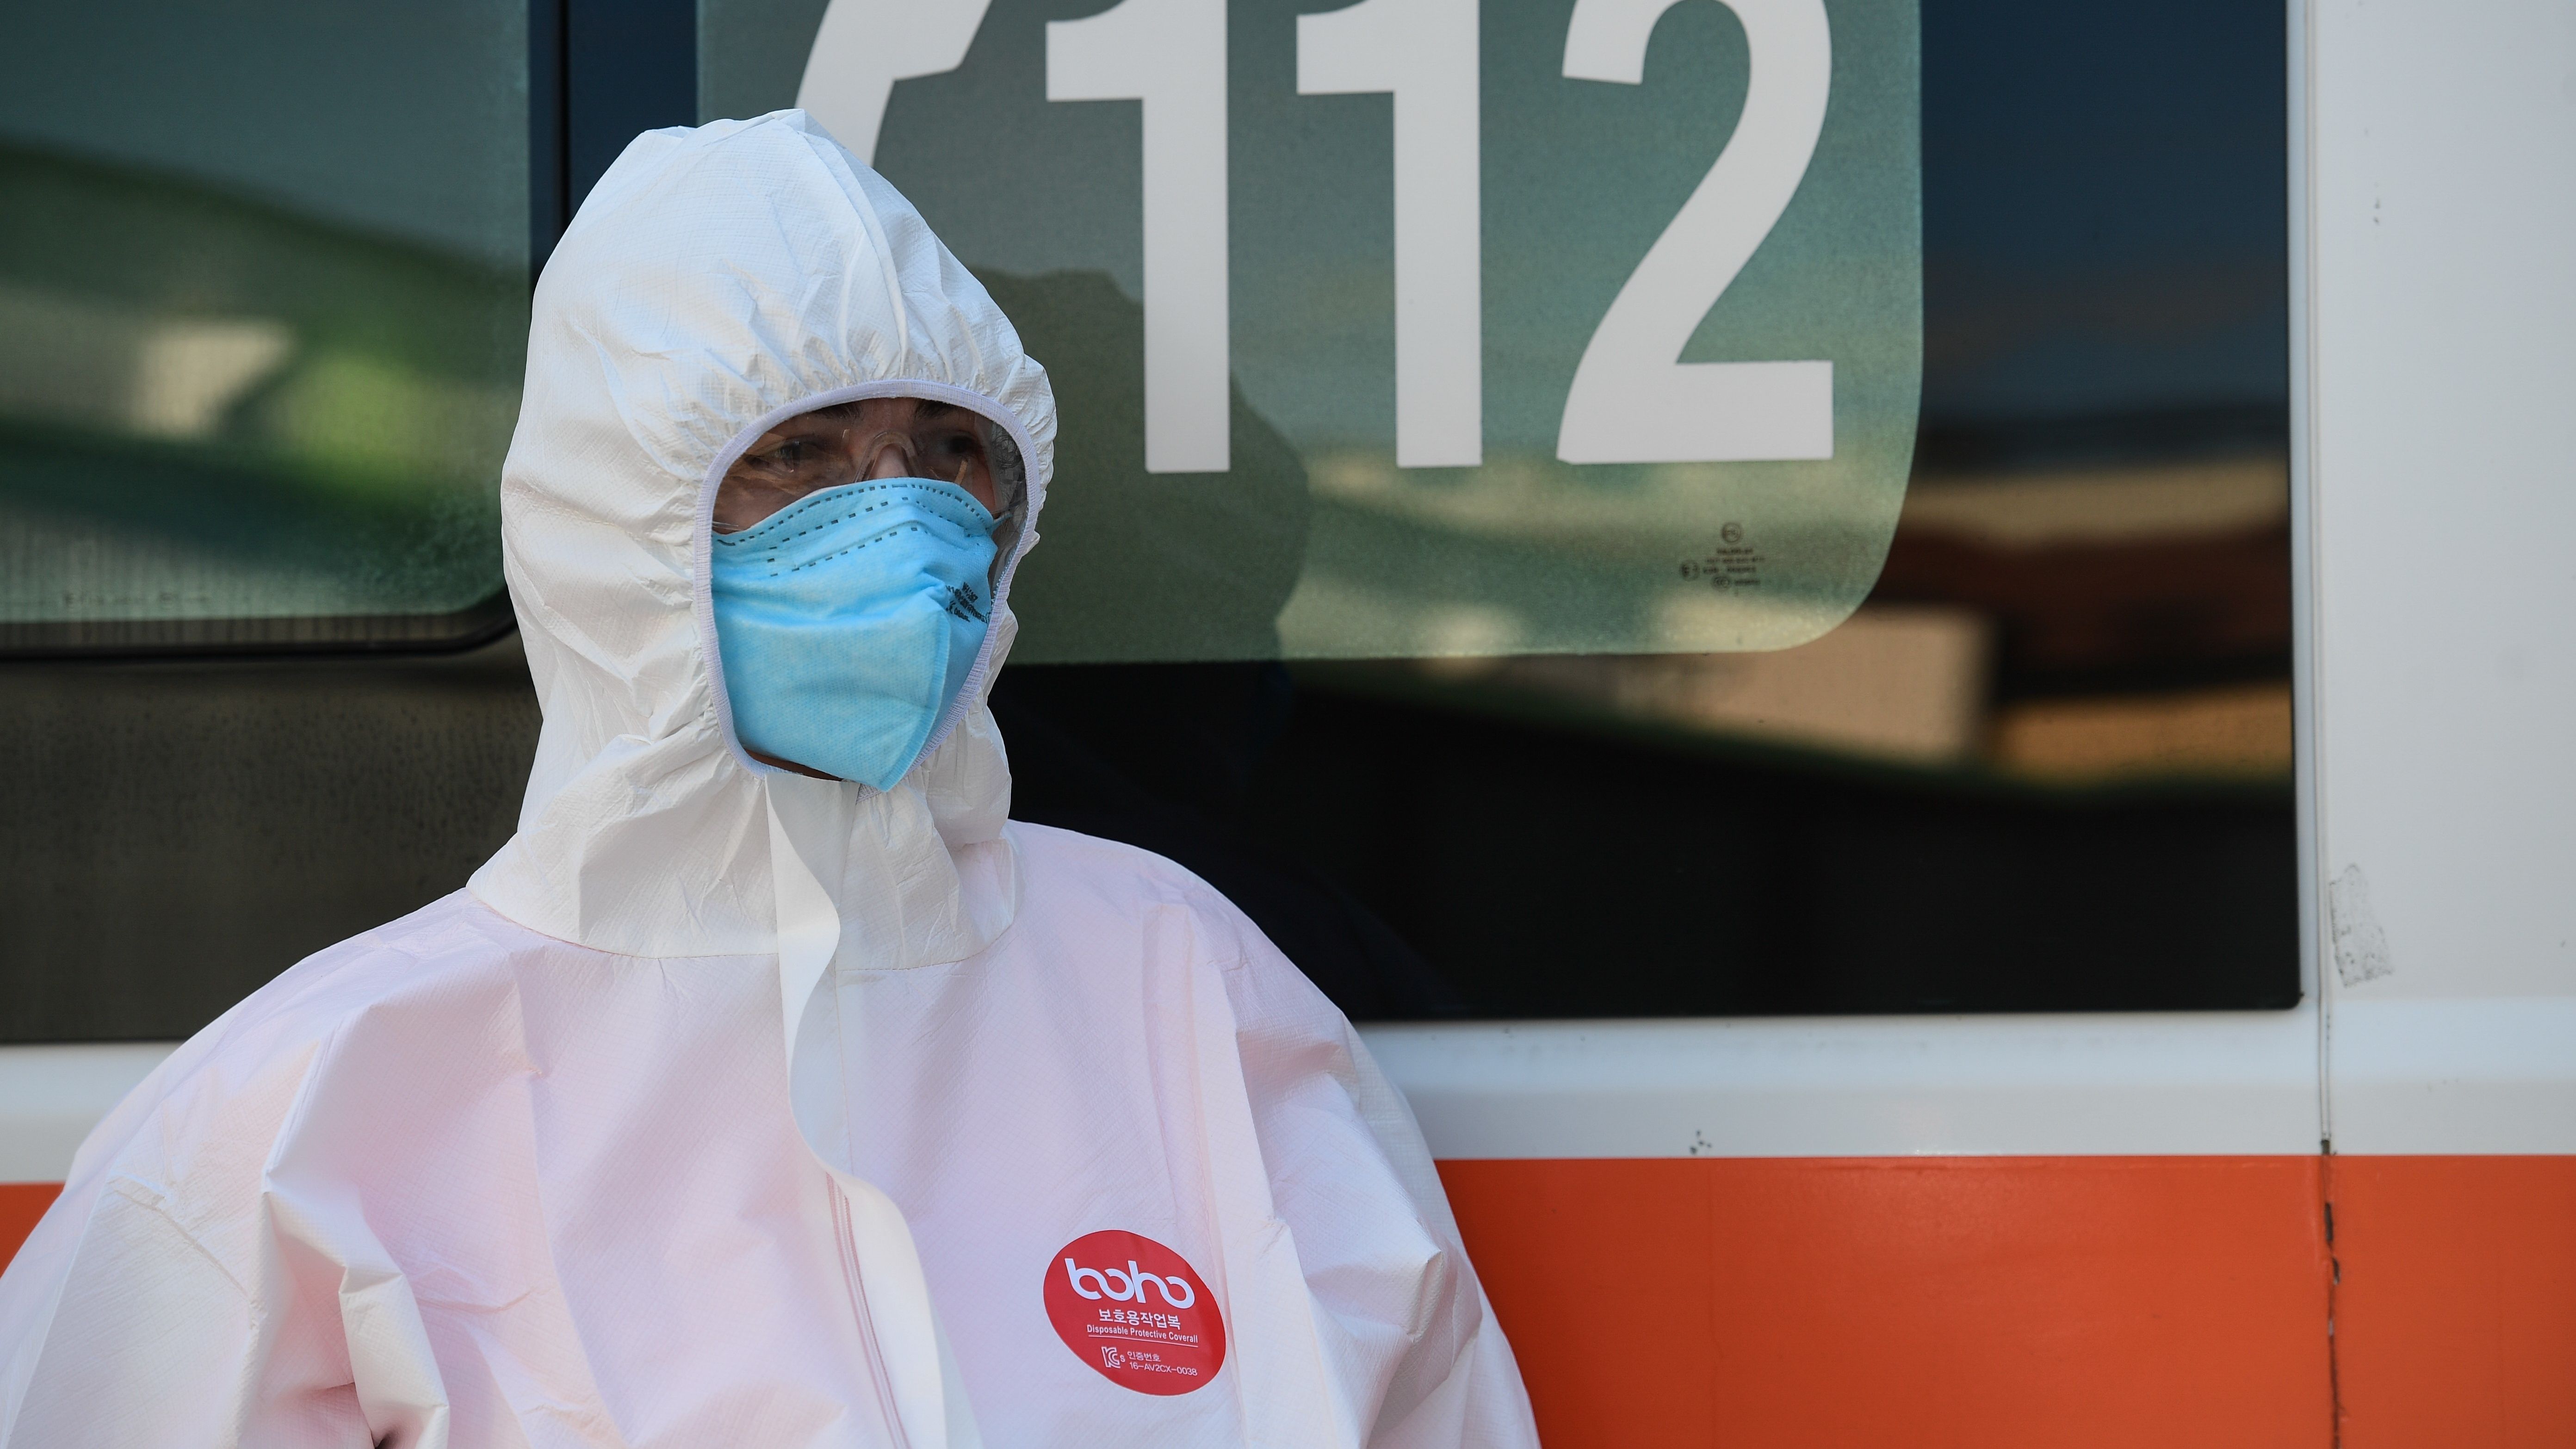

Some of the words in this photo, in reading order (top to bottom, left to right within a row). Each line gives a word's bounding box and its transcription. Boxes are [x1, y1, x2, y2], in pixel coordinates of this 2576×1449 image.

[1046, 0, 1833, 472] 112
[1065, 1258, 1195, 1309] boho
[1099, 1309, 1181, 1330] 보호용작업복
[1087, 1325, 1128, 1335] Disposable
[1130, 1329, 1167, 1339] Protective
[1169, 1331, 1198, 1344] Coverall
[1127, 1351, 1161, 1362] 인증번호
[1129, 1362, 1198, 1376] 16-AV2CX-0038
